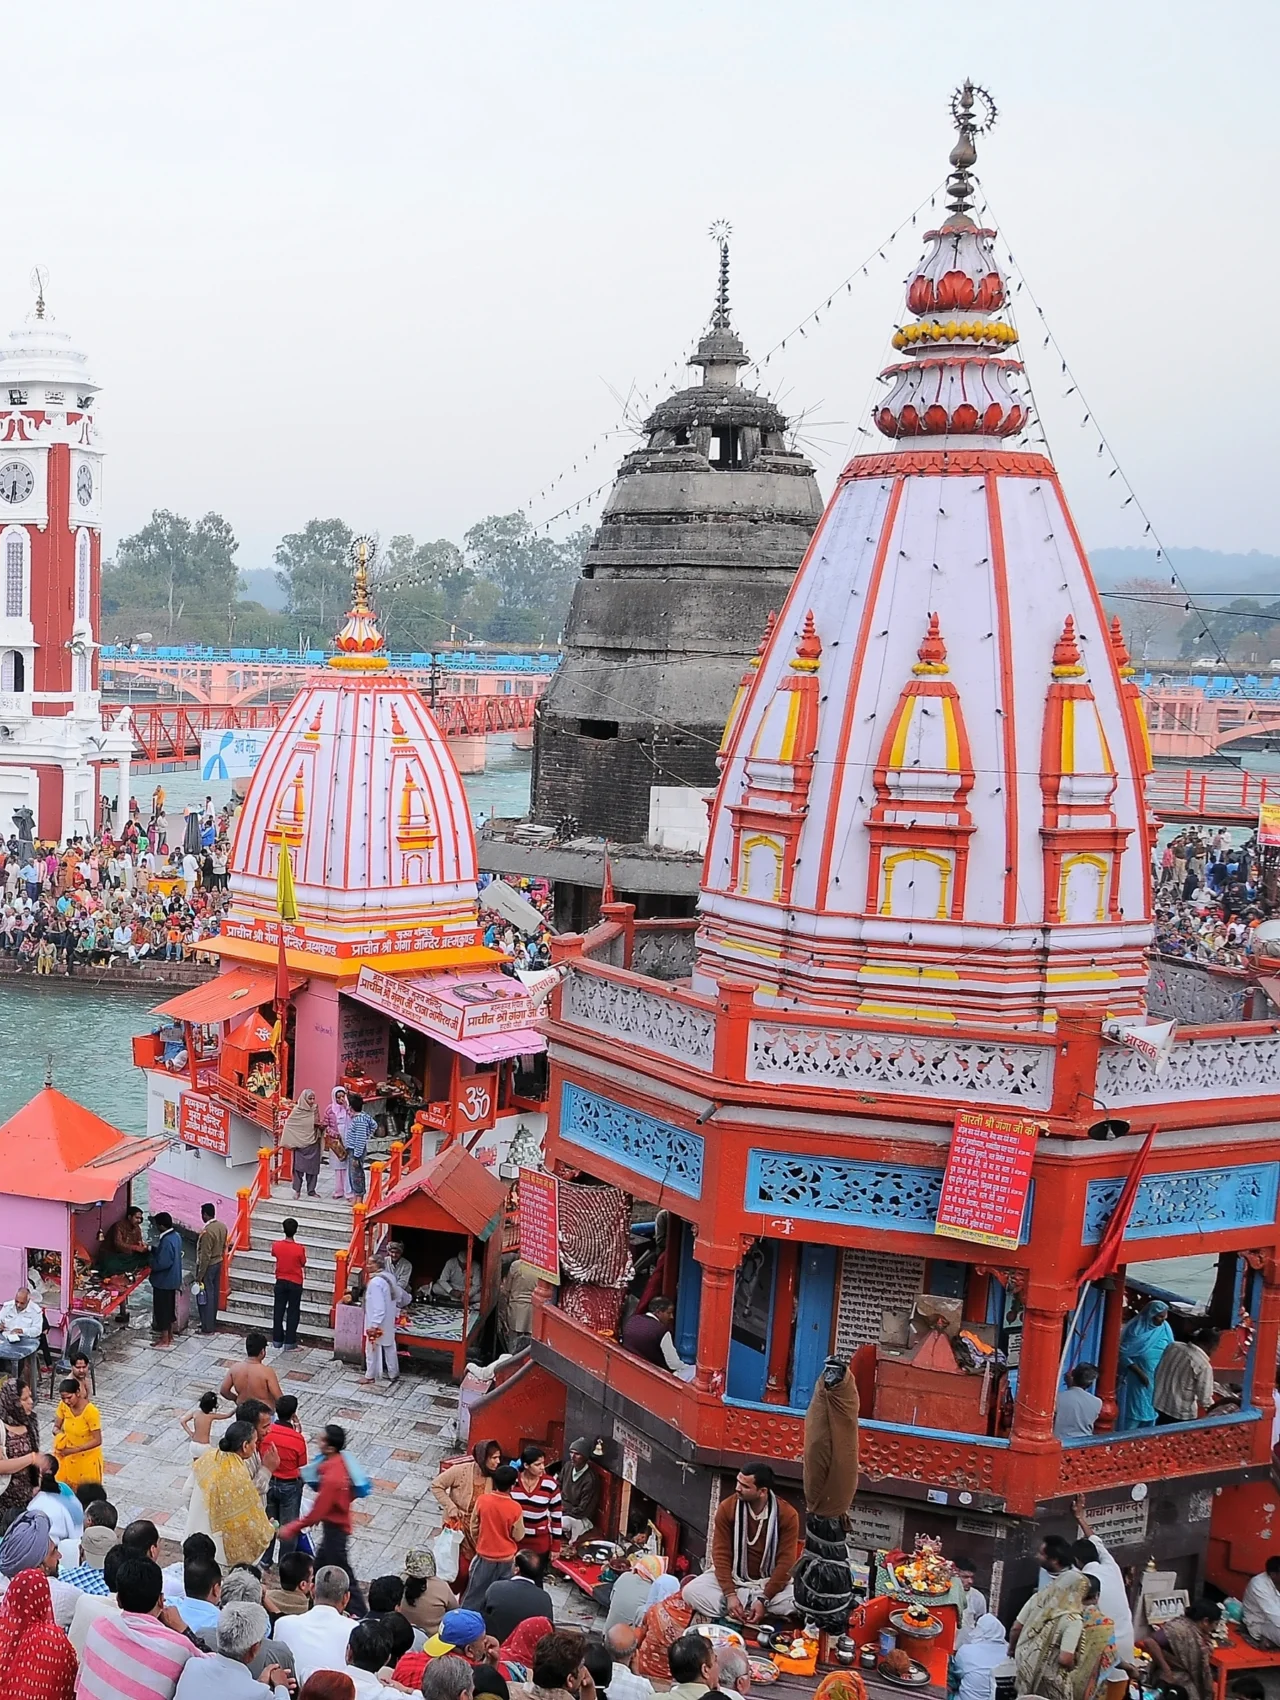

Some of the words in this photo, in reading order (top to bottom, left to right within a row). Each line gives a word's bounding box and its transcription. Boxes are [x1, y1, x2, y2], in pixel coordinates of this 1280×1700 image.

[253, 929, 264, 943] श्री
[351, 940, 380, 956] प्राचीन
[381, 940, 392, 954] श्री
[468, 1012, 495, 1027] प्राचीन
[496, 1011, 507, 1023] श्री
[960, 1114, 983, 1127] आरती
[985, 1116, 995, 1128] श्री
[996, 1120, 1011, 1133] गंगा
[1012, 1120, 1024, 1135] जी
[1024, 1124, 1036, 1137] की
